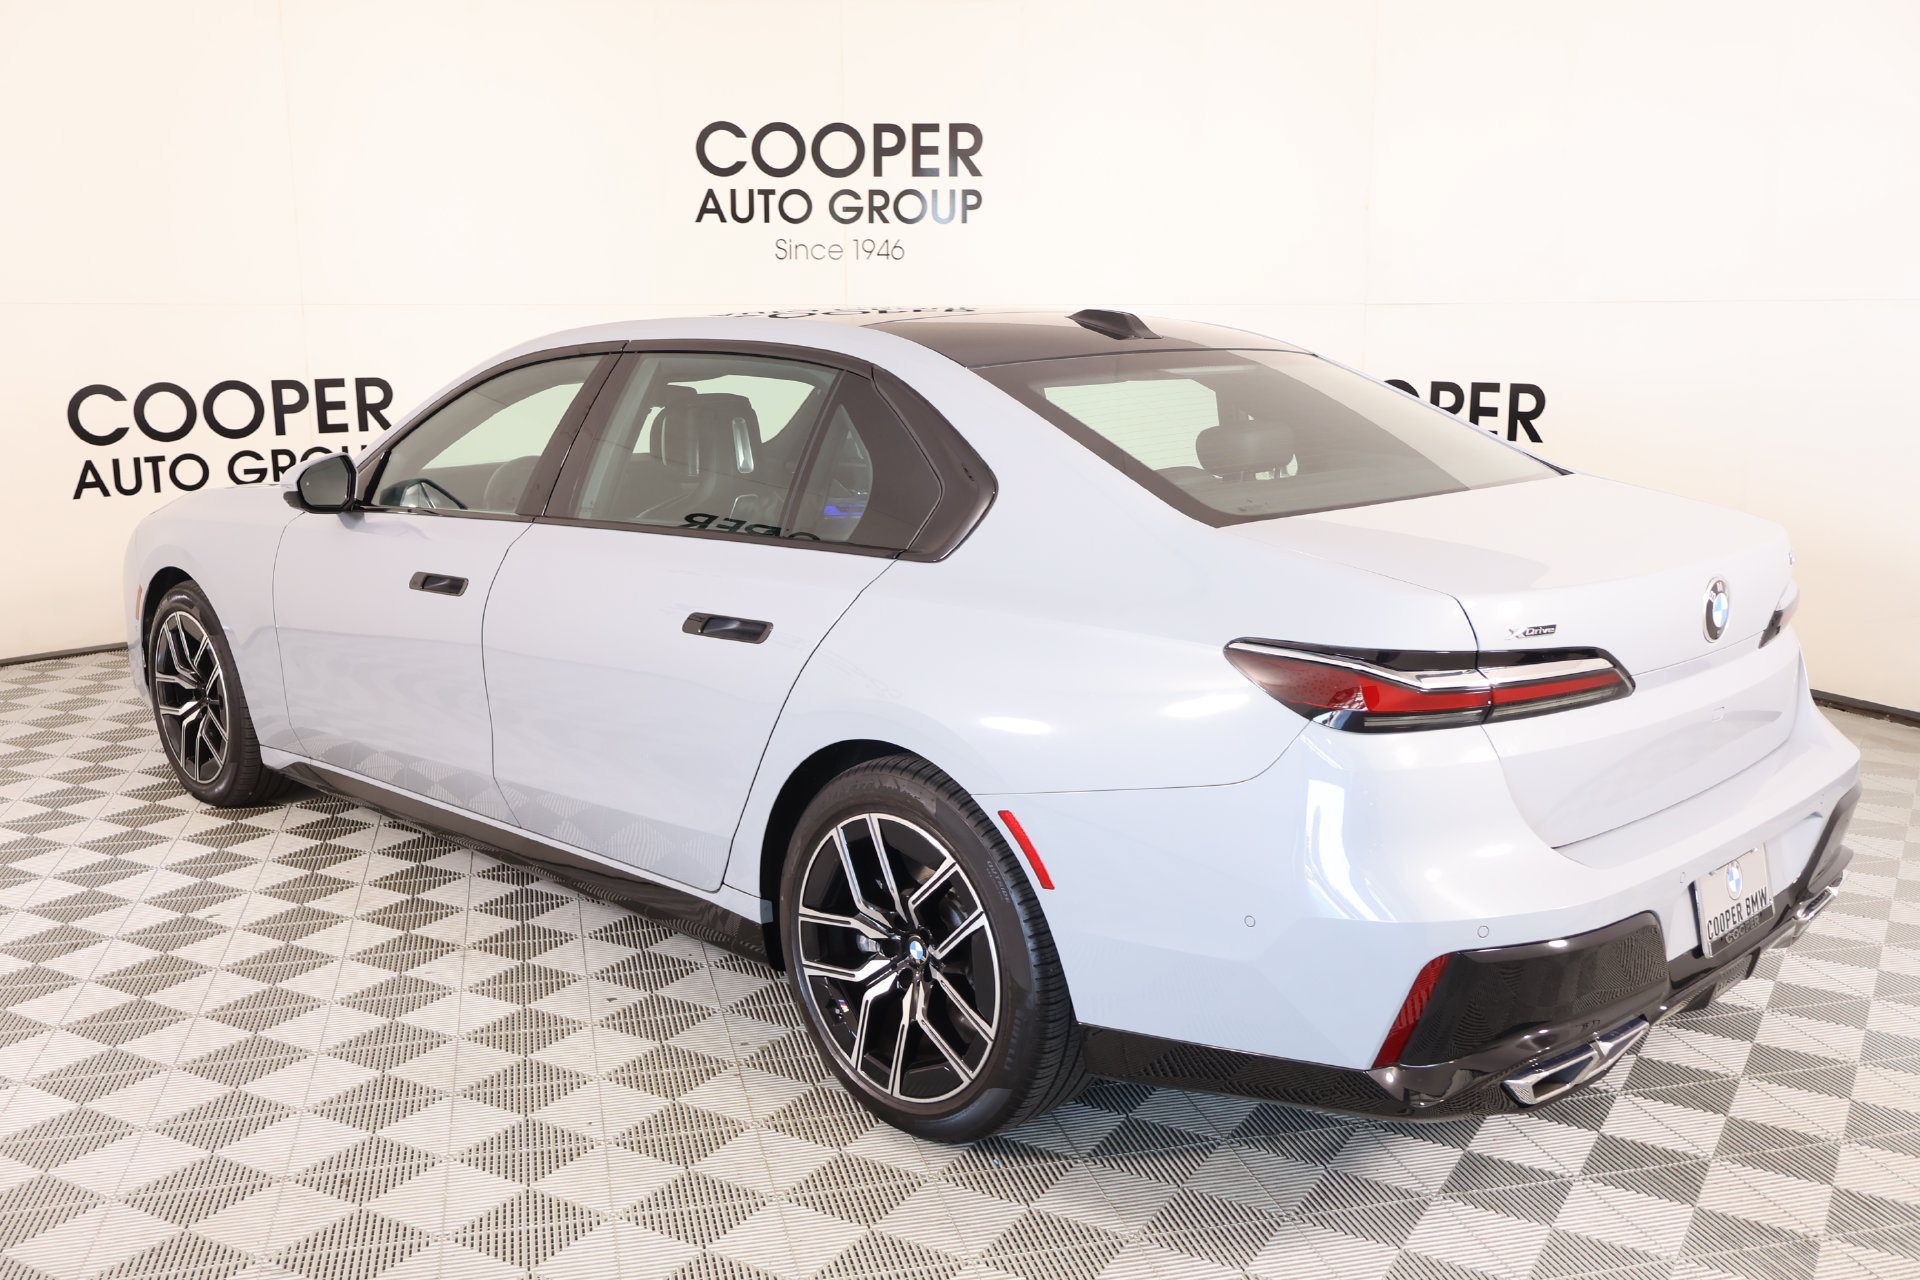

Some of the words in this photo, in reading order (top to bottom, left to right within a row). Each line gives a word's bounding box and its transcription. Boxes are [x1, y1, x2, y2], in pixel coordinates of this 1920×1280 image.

[696, 121, 983, 178] COOPER
[695, 189, 812, 224] AUTO
[828, 189, 983, 225] GROUP
[775, 239, 843, 260] Since
[853, 239, 904, 260] 1946
[67, 377, 393, 446] COOPER
[1384, 379, 1546, 443] PER
[73, 453, 210, 499] AUTO
[1707, 902, 1743, 940] COOPER
[1745, 886, 1767, 916] BMW
